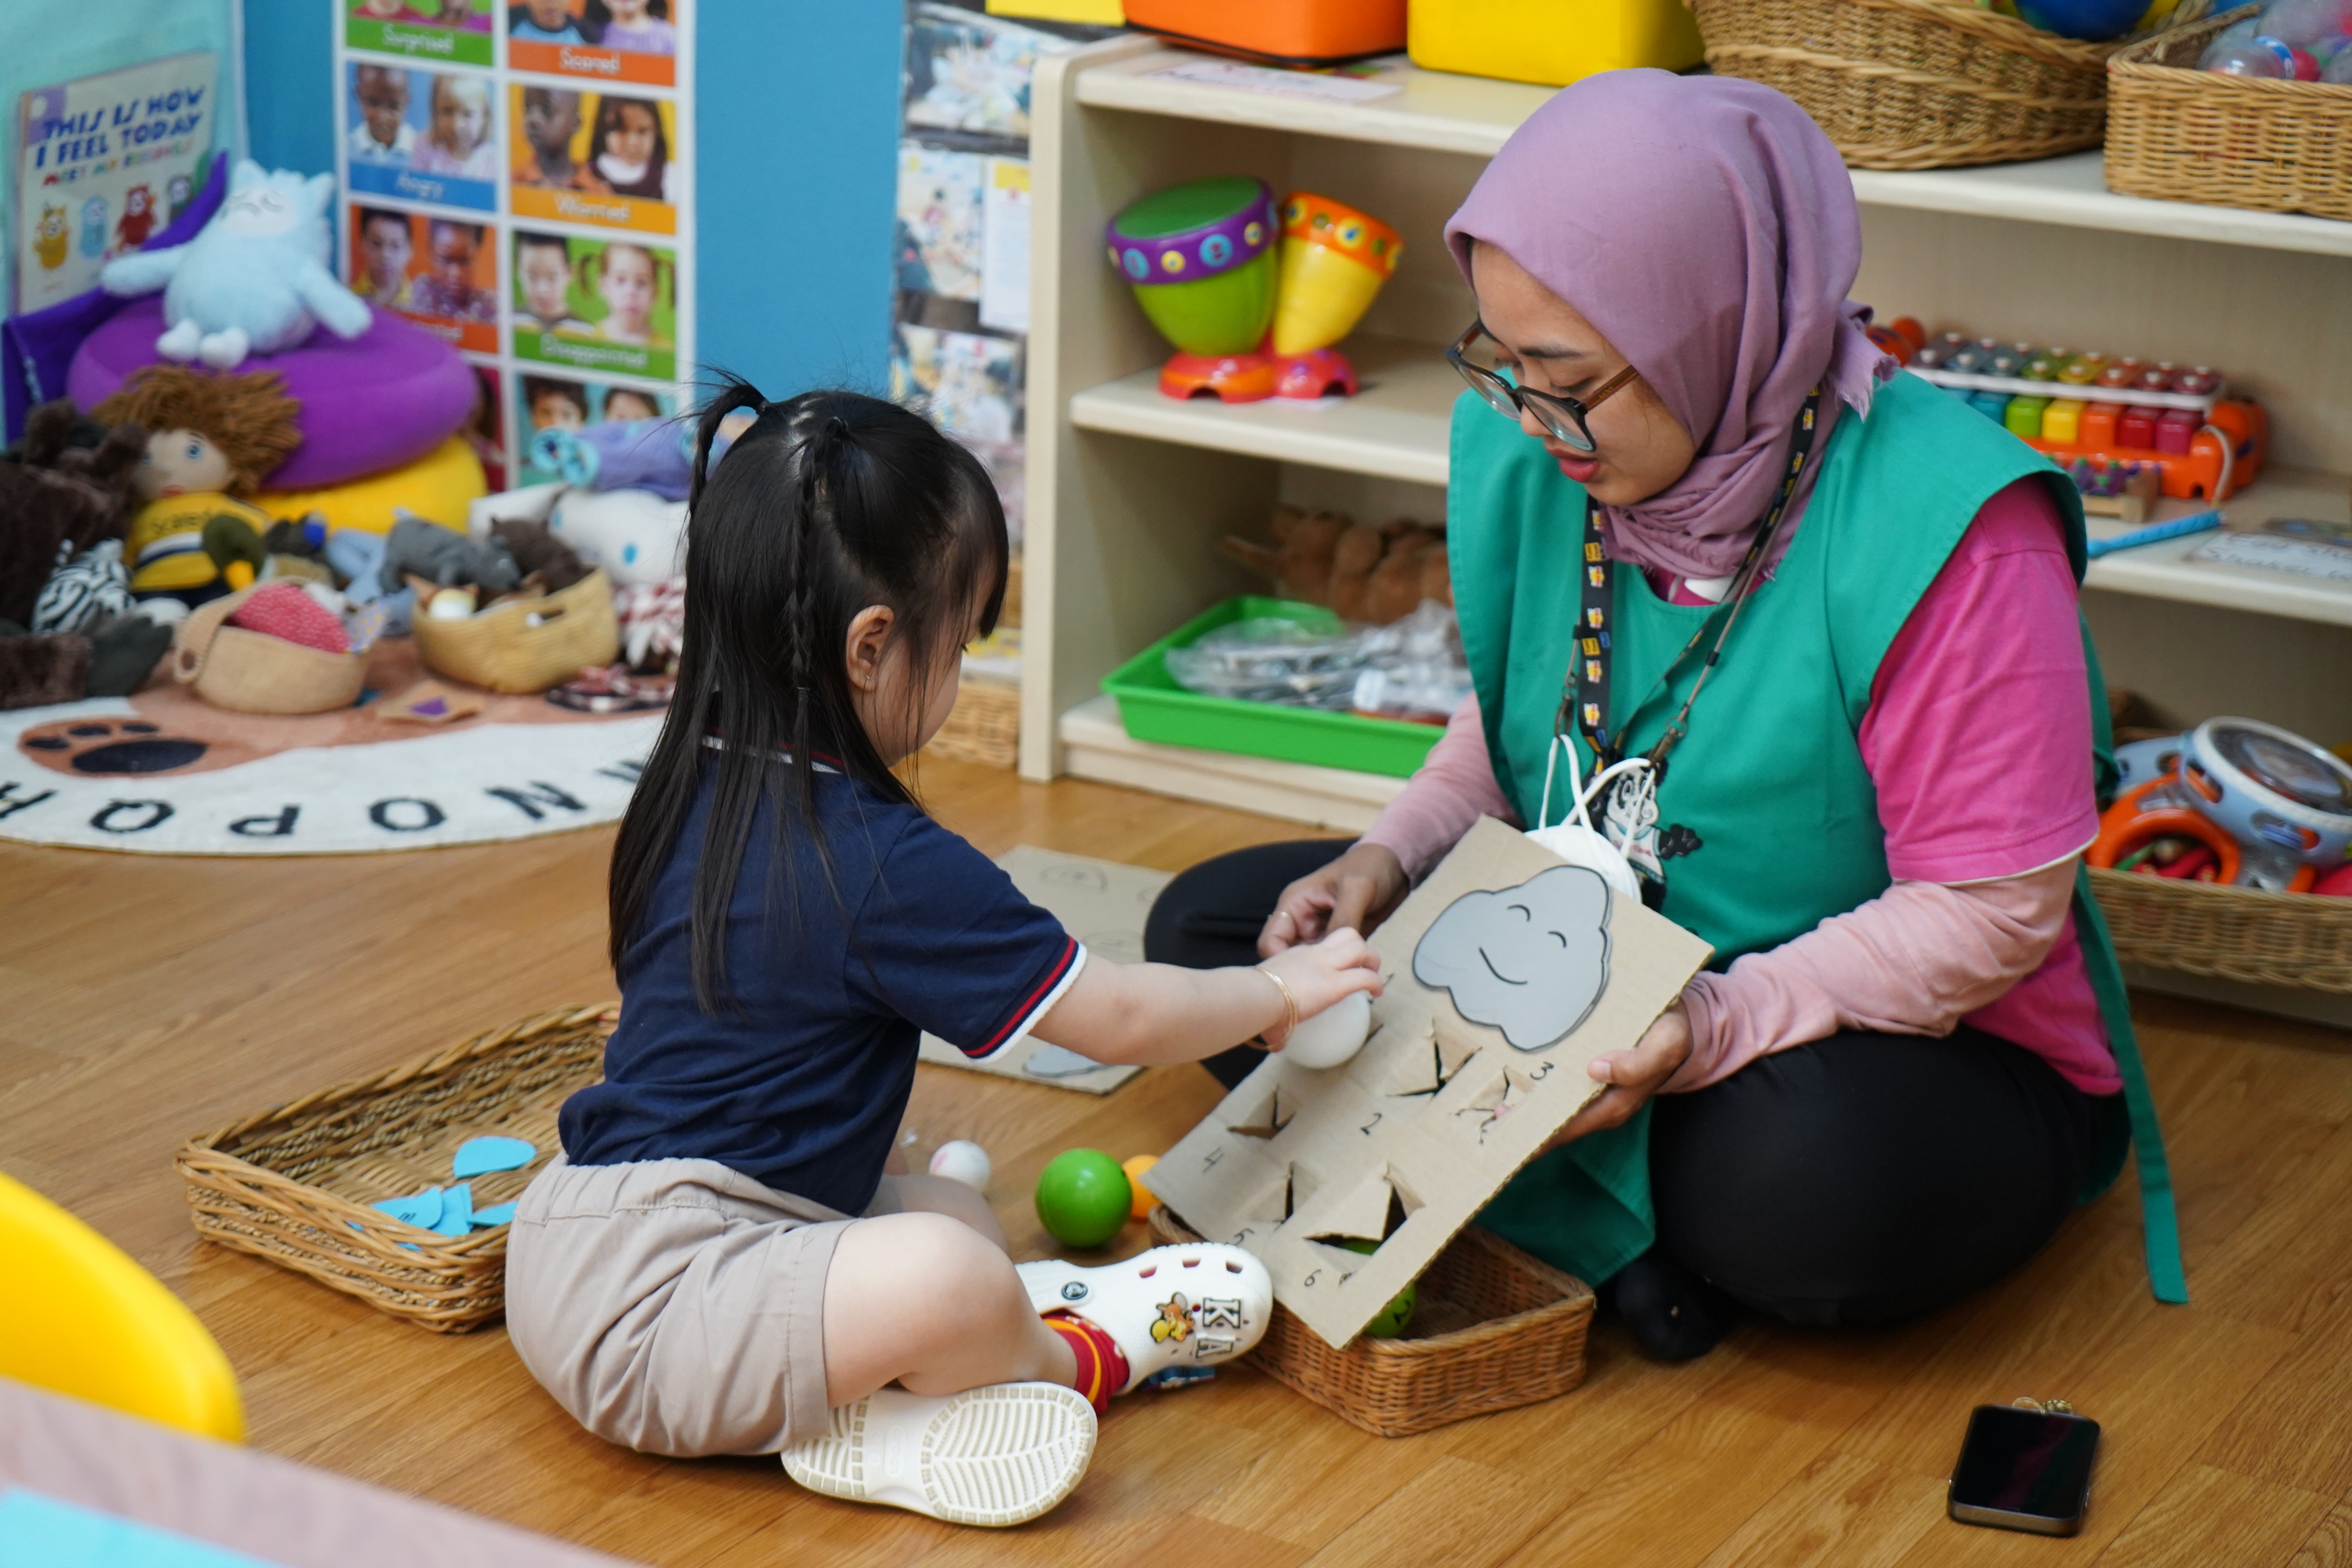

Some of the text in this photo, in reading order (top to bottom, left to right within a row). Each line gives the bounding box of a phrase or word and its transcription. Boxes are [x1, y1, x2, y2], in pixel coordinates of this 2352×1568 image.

[383, 24, 454, 54] Surprised
[560, 48, 620, 74] Scared
[43, 87, 205, 140] THIS IS HOW
[58, 136, 108, 164] FEEL
[121, 115, 201, 146] TODAY
[556, 196, 629, 220] Worried
[229, 804, 301, 836] P
[368, 797, 446, 832] O
[1530, 1061, 1554, 1080] 3
[1360, 1112, 1382, 1135] 2
[1202, 1146, 1225, 1173] 4
[1304, 1269, 1322, 1287] 6
